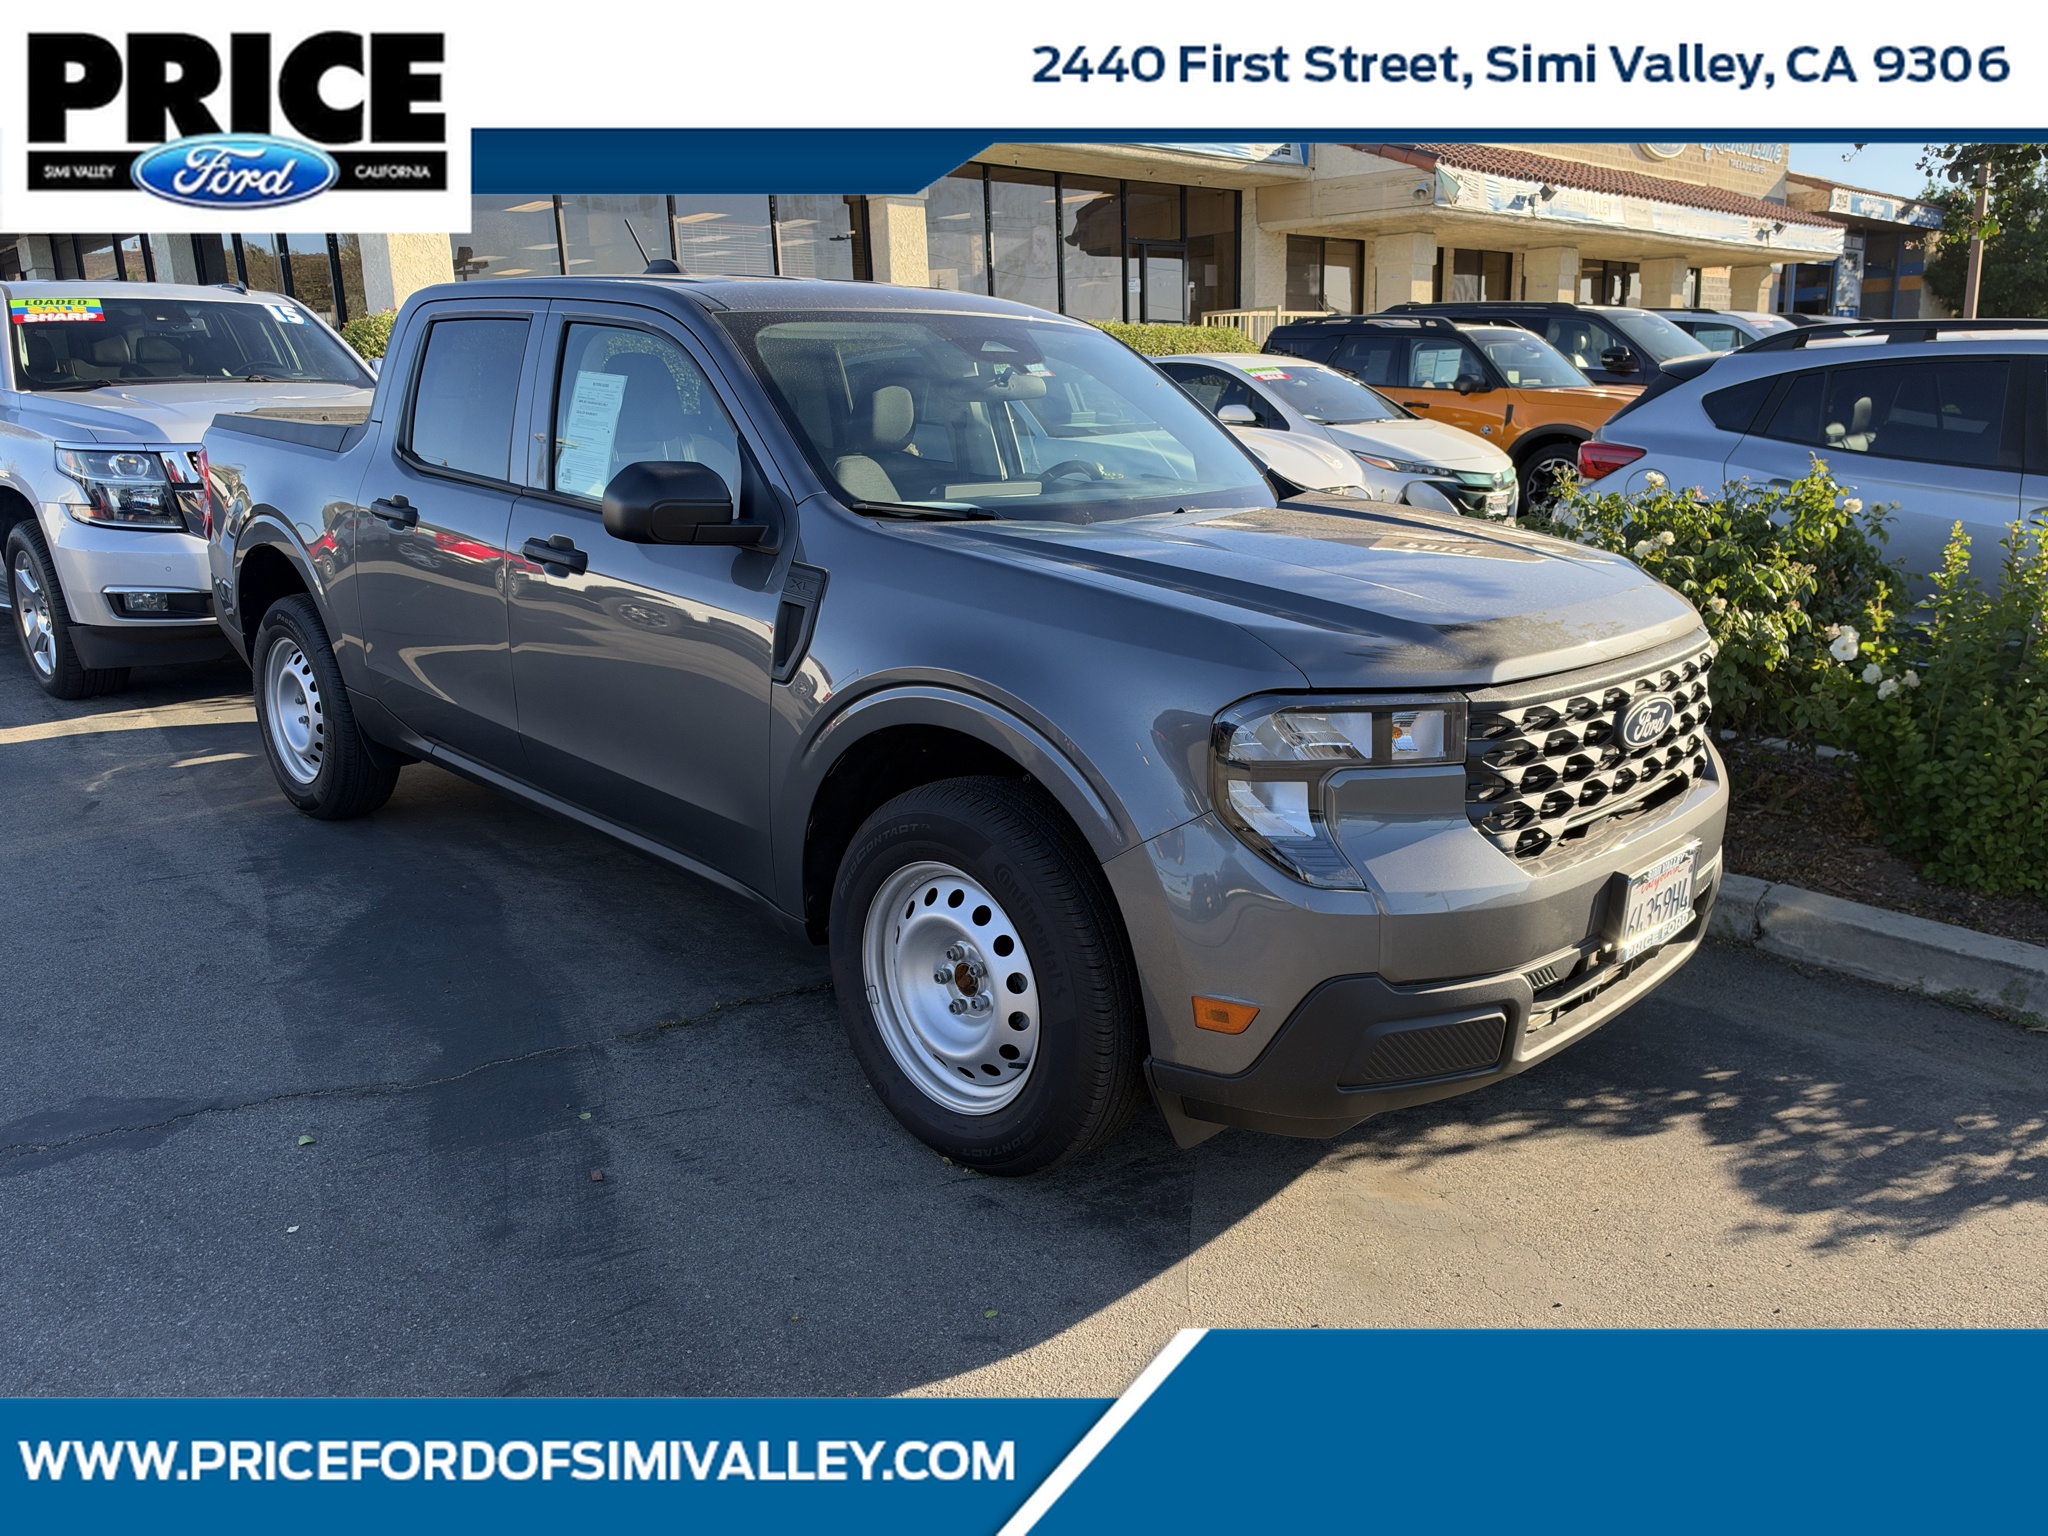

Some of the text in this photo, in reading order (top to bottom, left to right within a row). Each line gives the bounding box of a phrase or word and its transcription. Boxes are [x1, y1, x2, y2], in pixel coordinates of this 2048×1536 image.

[23, 312, 97, 322] SHARP
[263, 304, 305, 324] 15
[790, 578, 813, 594] XL
[1634, 705, 1665, 741] Ford
[1626, 913, 1689, 960] PRICE FORD
